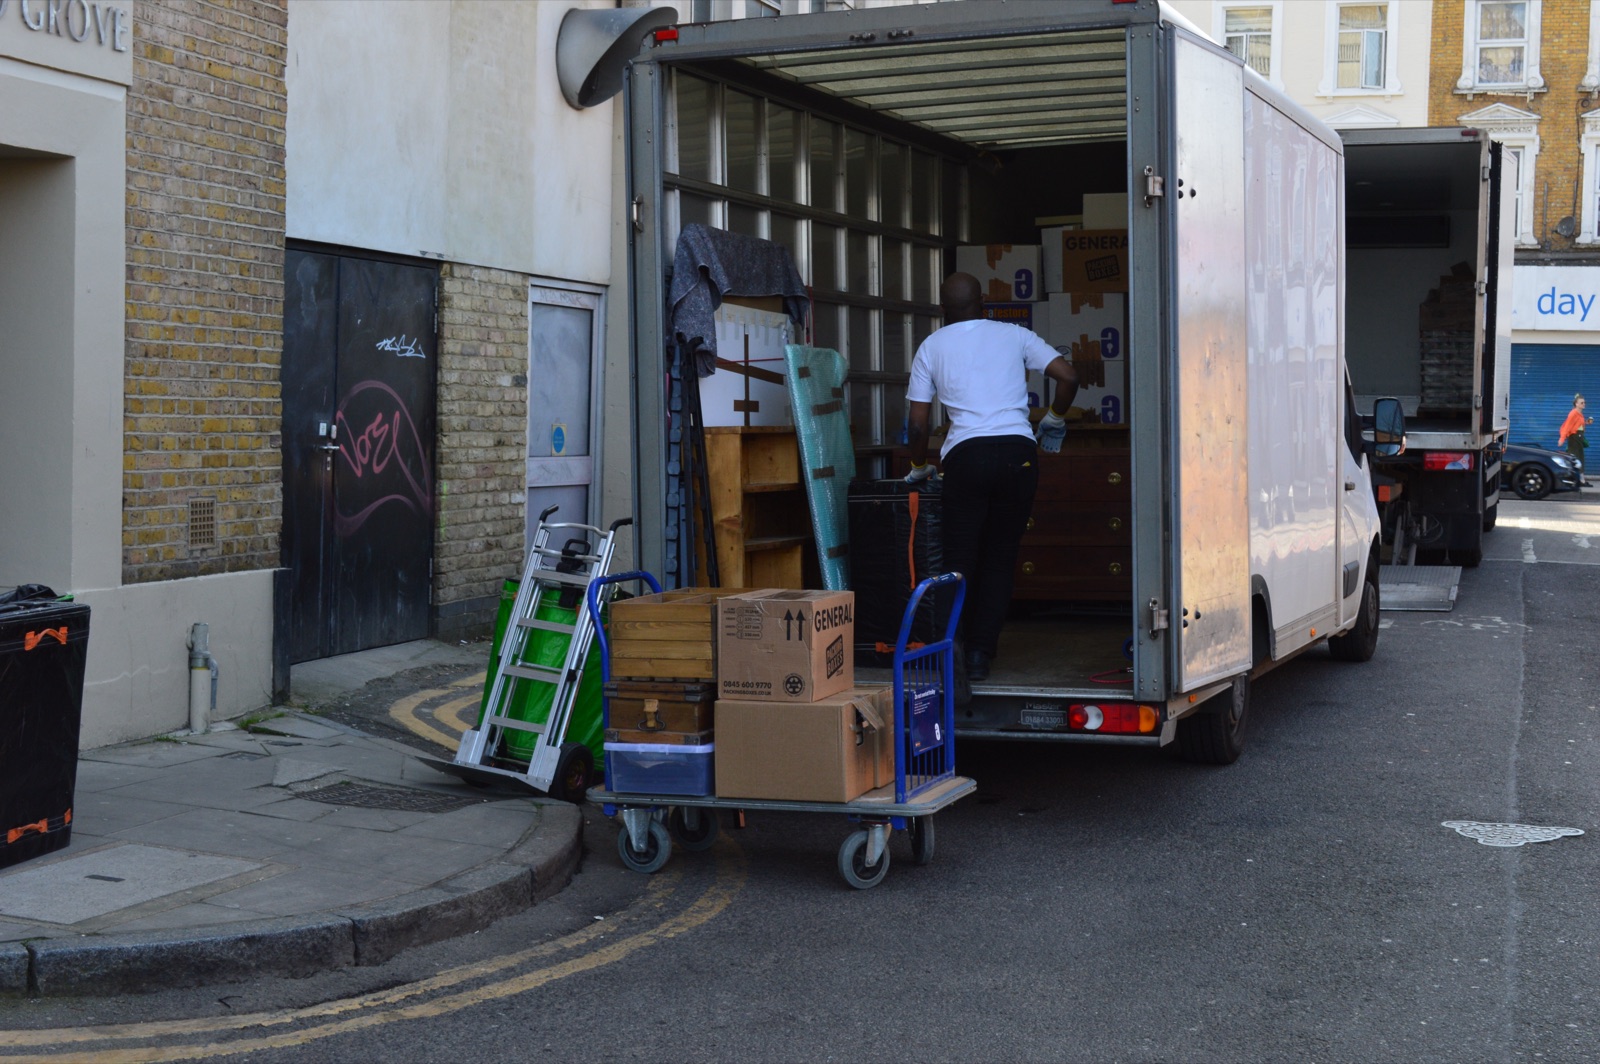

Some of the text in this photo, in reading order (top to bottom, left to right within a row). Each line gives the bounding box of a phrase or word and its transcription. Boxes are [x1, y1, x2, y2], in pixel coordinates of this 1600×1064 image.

[20, 0, 128, 52] GROVE
[1066, 236, 1129, 250] GENERA
[1537, 286, 1596, 322] day
[814, 603, 853, 632] GENERAL
[723, 680, 772, 689] 0845 600 9770
